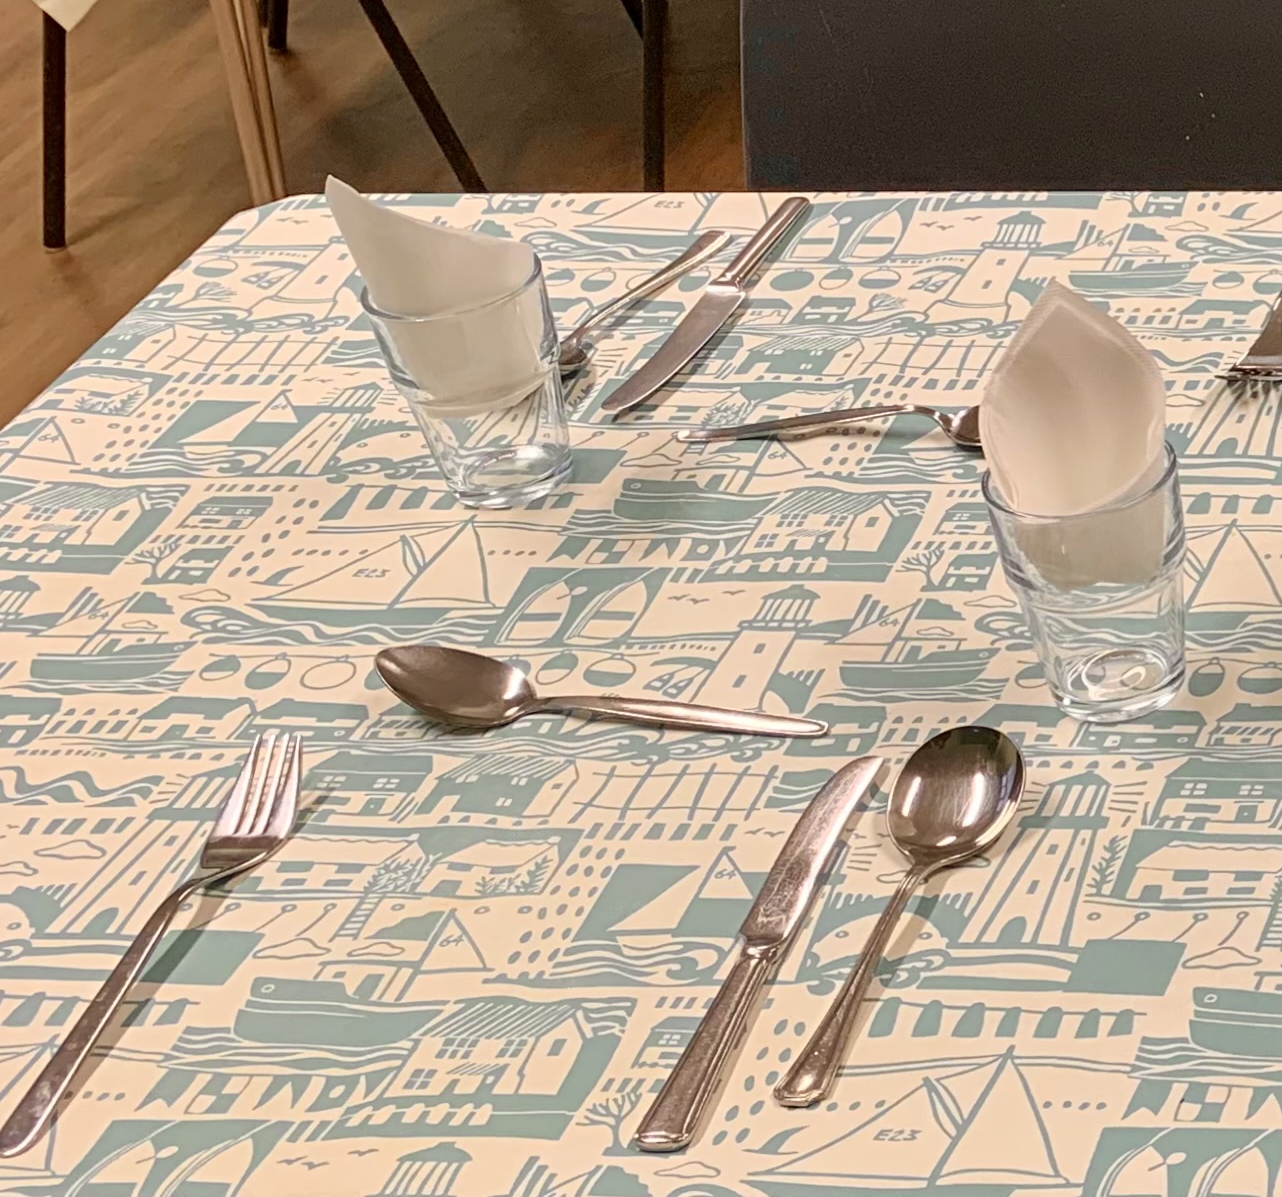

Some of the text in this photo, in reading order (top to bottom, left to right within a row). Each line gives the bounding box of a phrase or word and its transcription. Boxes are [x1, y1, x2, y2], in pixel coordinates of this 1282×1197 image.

[653, 200, 685, 209] E23
[768, 450, 788, 460] 64
[352, 568, 392, 578] E23
[88, 610, 110, 620] 64
[879, 617, 901, 628] 64
[714, 869, 737, 880] 64
[439, 933, 464, 947] 64
[872, 1129, 922, 1141] E23
